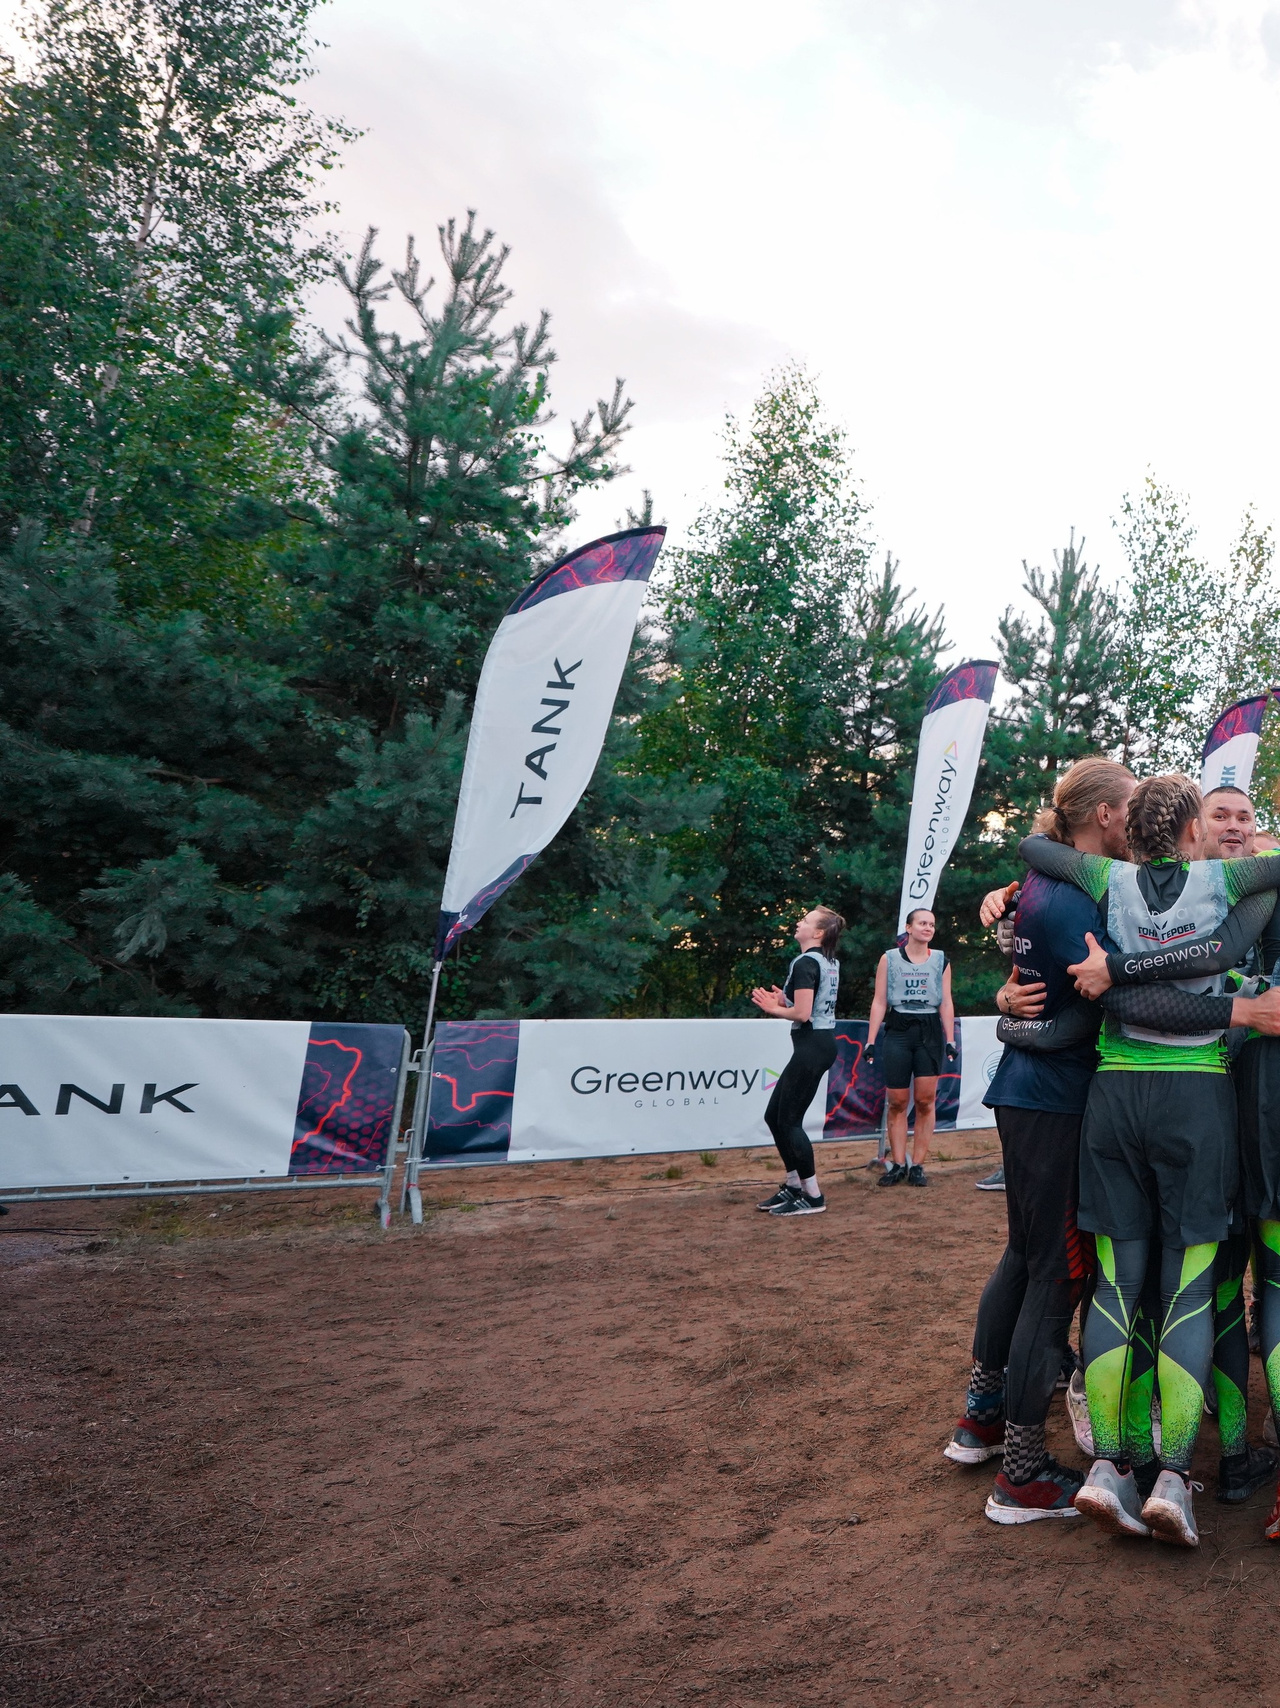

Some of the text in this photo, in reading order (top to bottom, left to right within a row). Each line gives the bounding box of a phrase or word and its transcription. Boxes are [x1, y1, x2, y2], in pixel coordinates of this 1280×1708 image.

[509, 657, 583, 819] TANK
[909, 759, 957, 900] Greenway
[940, 794, 953, 856] GLOBAL
[1161, 922, 1196, 940] ГЕРОЕВ
[1124, 942, 1210, 974] Greenway
[1152, 961, 1196, 974] GLOBAL
[570, 1065, 760, 1096] Greenway
[0, 1083, 200, 1116] ANK
[634, 1096, 719, 1109] GLOBAL
